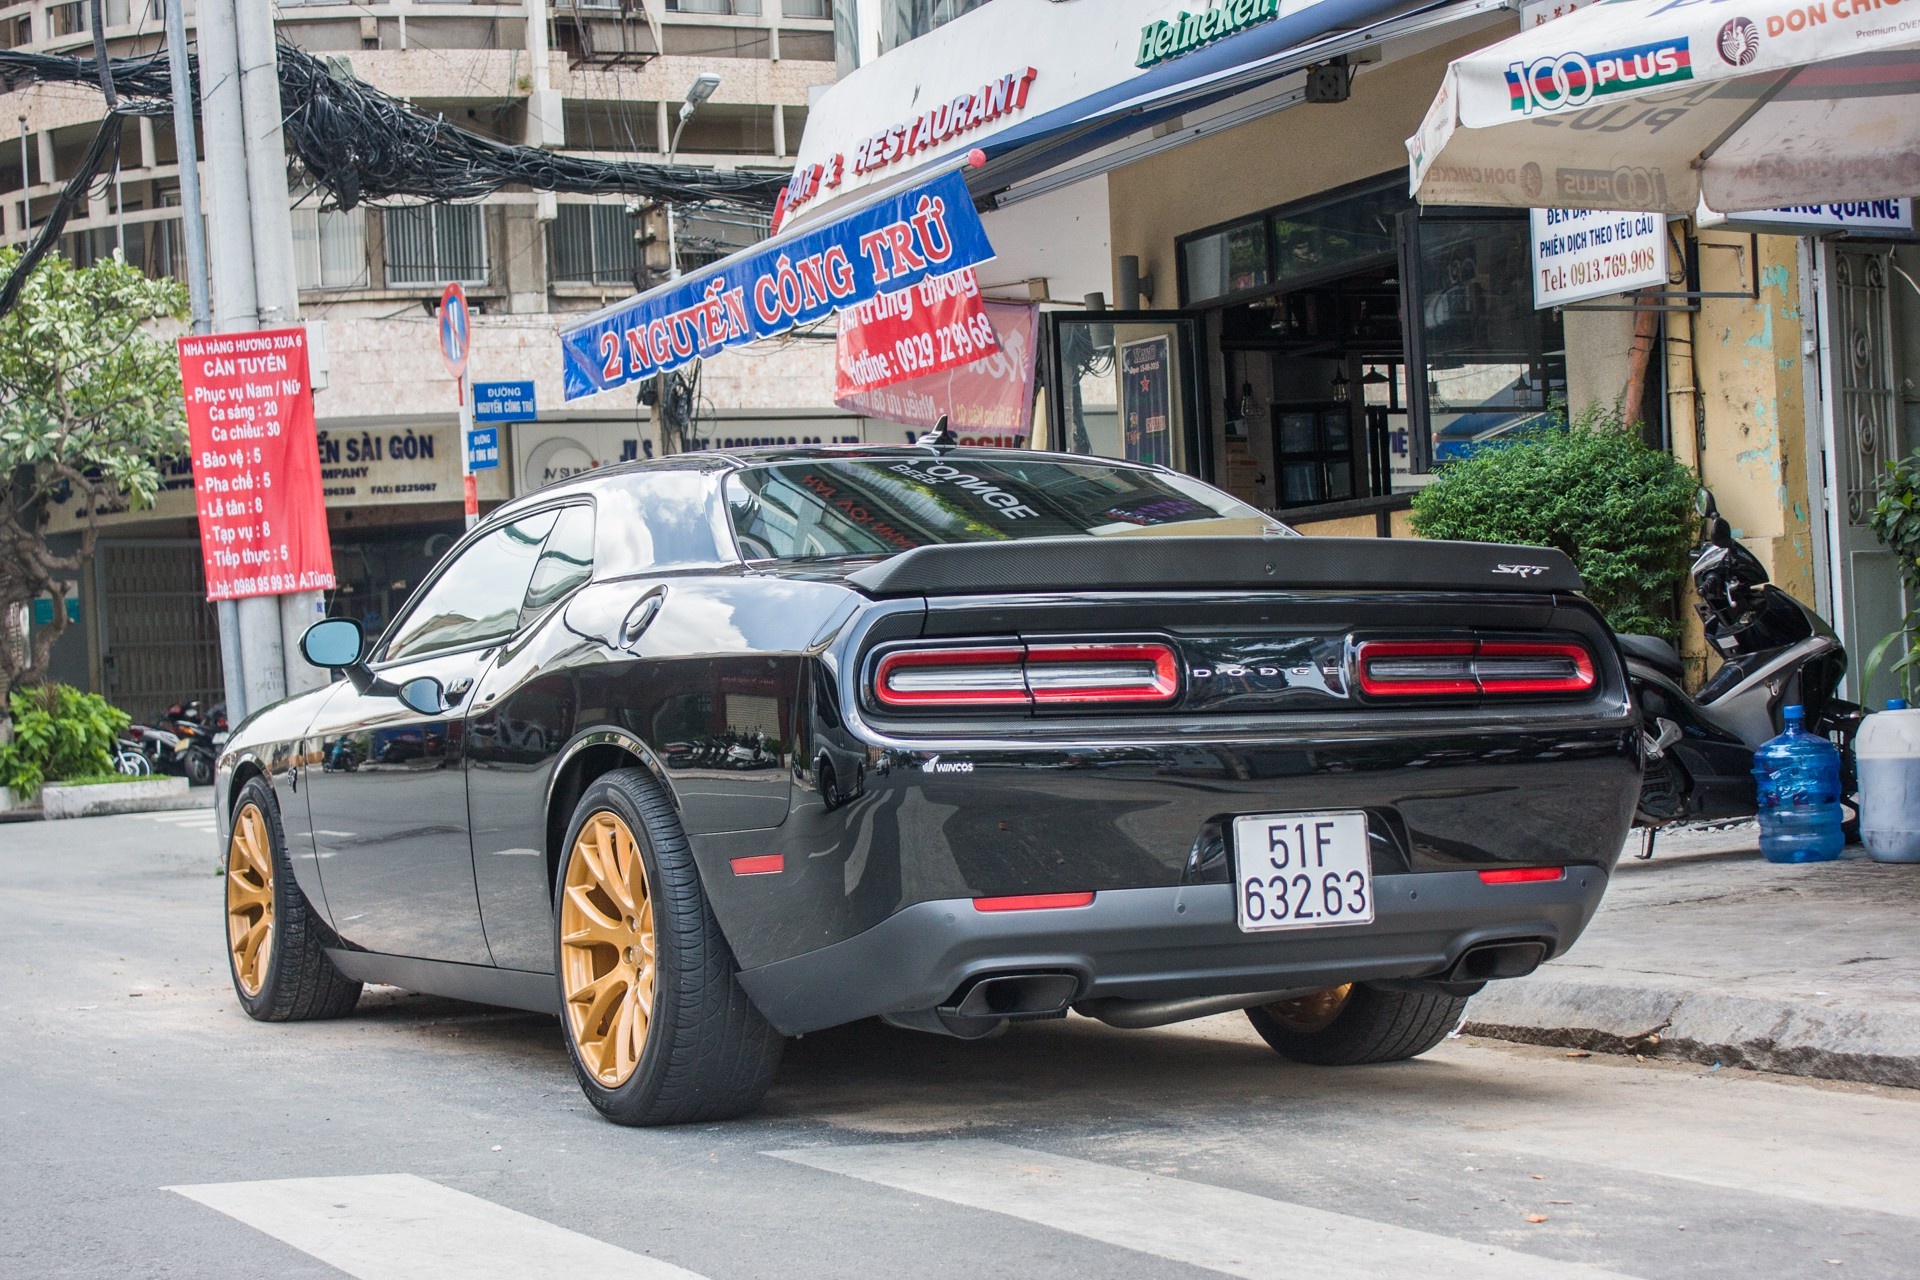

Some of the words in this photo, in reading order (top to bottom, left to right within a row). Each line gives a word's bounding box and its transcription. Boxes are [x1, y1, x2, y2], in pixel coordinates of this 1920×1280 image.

[1766, 3, 1828, 37] DON
[1135, 0, 1277, 68] Heineken
[1856, 26, 1897, 39] Premium
[1597, 48, 1678, 86] PLUS
[782, 163, 824, 212] BAR
[824, 153, 844, 189] &
[851, 66, 1037, 176] RESTAURANT
[1567, 231, 1587, 255] DỊCH
[1589, 225, 1612, 247] THEO
[1614, 217, 1633, 241] YÊU
[1541, 266, 1567, 293] Tel:
[1570, 246, 1655, 287] 0913.769.908
[600, 330, 624, 383] 2
[625, 277, 750, 373] NGUYỄN
[754, 244, 856, 325] CÔNG
[860, 194, 953, 285] TRỨ
[184, 340, 205, 356] NHÀ
[206, 338, 234, 355] HÀNG
[236, 337, 272, 353] HƯƠNG
[295, 335, 302, 347] 6
[228, 387, 244, 404] vụ
[245, 382, 273, 399] Nam
[209, 405, 225, 421] Ca
[227, 402, 255, 421] sáng
[264, 401, 278, 417] 20
[211, 426, 228, 442] Ca
[266, 421, 280, 437] 30
[346, 431, 383, 462] SÀI
[389, 428, 434, 460] GÒN
[229, 449, 244, 468] vệ
[253, 447, 262, 464] 5
[205, 476, 229, 494] Pha
[231, 470, 254, 491] chế
[263, 471, 272, 488] 5
[207, 497, 224, 518] Lễ
[225, 499, 246, 516] tân
[255, 497, 263, 513] 8
[211, 525, 235, 544] Tạp
[237, 526, 253, 543] vụ
[262, 521, 271, 537] 8
[213, 546, 240, 569] Tiếp
[242, 548, 271, 566] thực
[280, 544, 288, 560] 5
[1491, 564, 1550, 578] SRT
[1193, 666, 1339, 678] DODGE
[936, 763, 974, 773] WINCOS
[1268, 821, 1335, 869] 51F
[1244, 870, 1366, 921] 632.63
